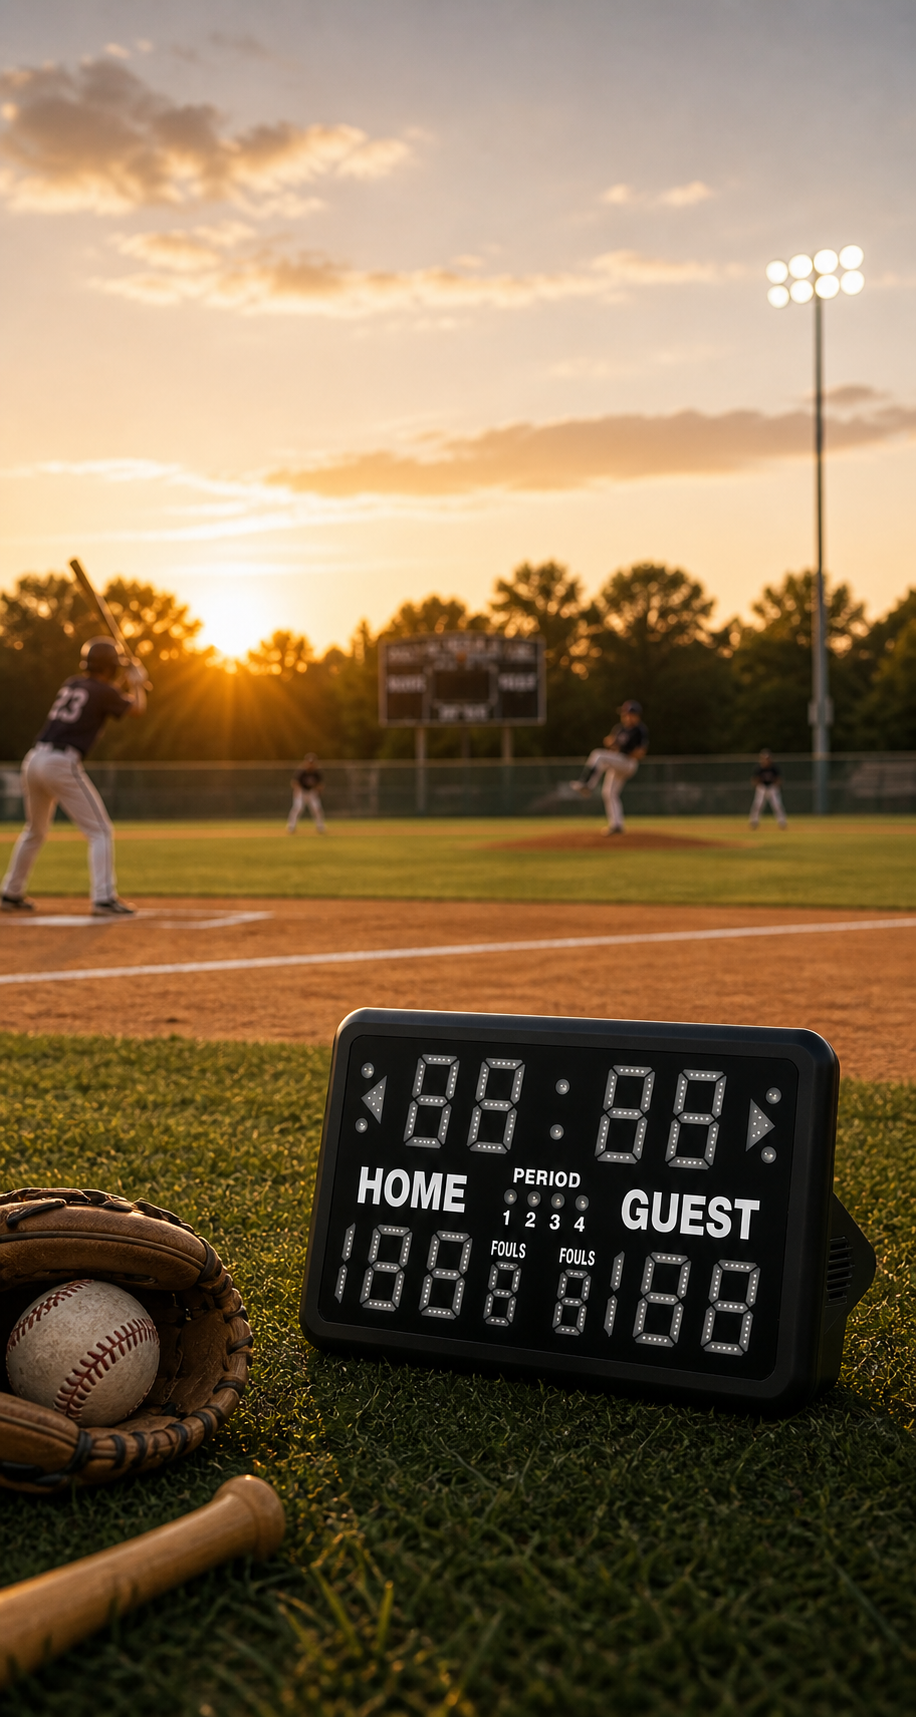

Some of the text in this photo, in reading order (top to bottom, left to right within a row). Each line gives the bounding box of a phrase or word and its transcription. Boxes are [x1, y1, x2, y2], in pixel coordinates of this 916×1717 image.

[48, 687, 90, 724] 23
[357, 1166, 467, 1212] HOME
[513, 1168, 581, 1188] PERIOD
[502, 1210, 586, 1233] 1 2 3 4
[622, 1189, 760, 1240] GUEST
[491, 1240, 526, 1259] FOULS
[559, 1248, 596, 1266] FOULS
